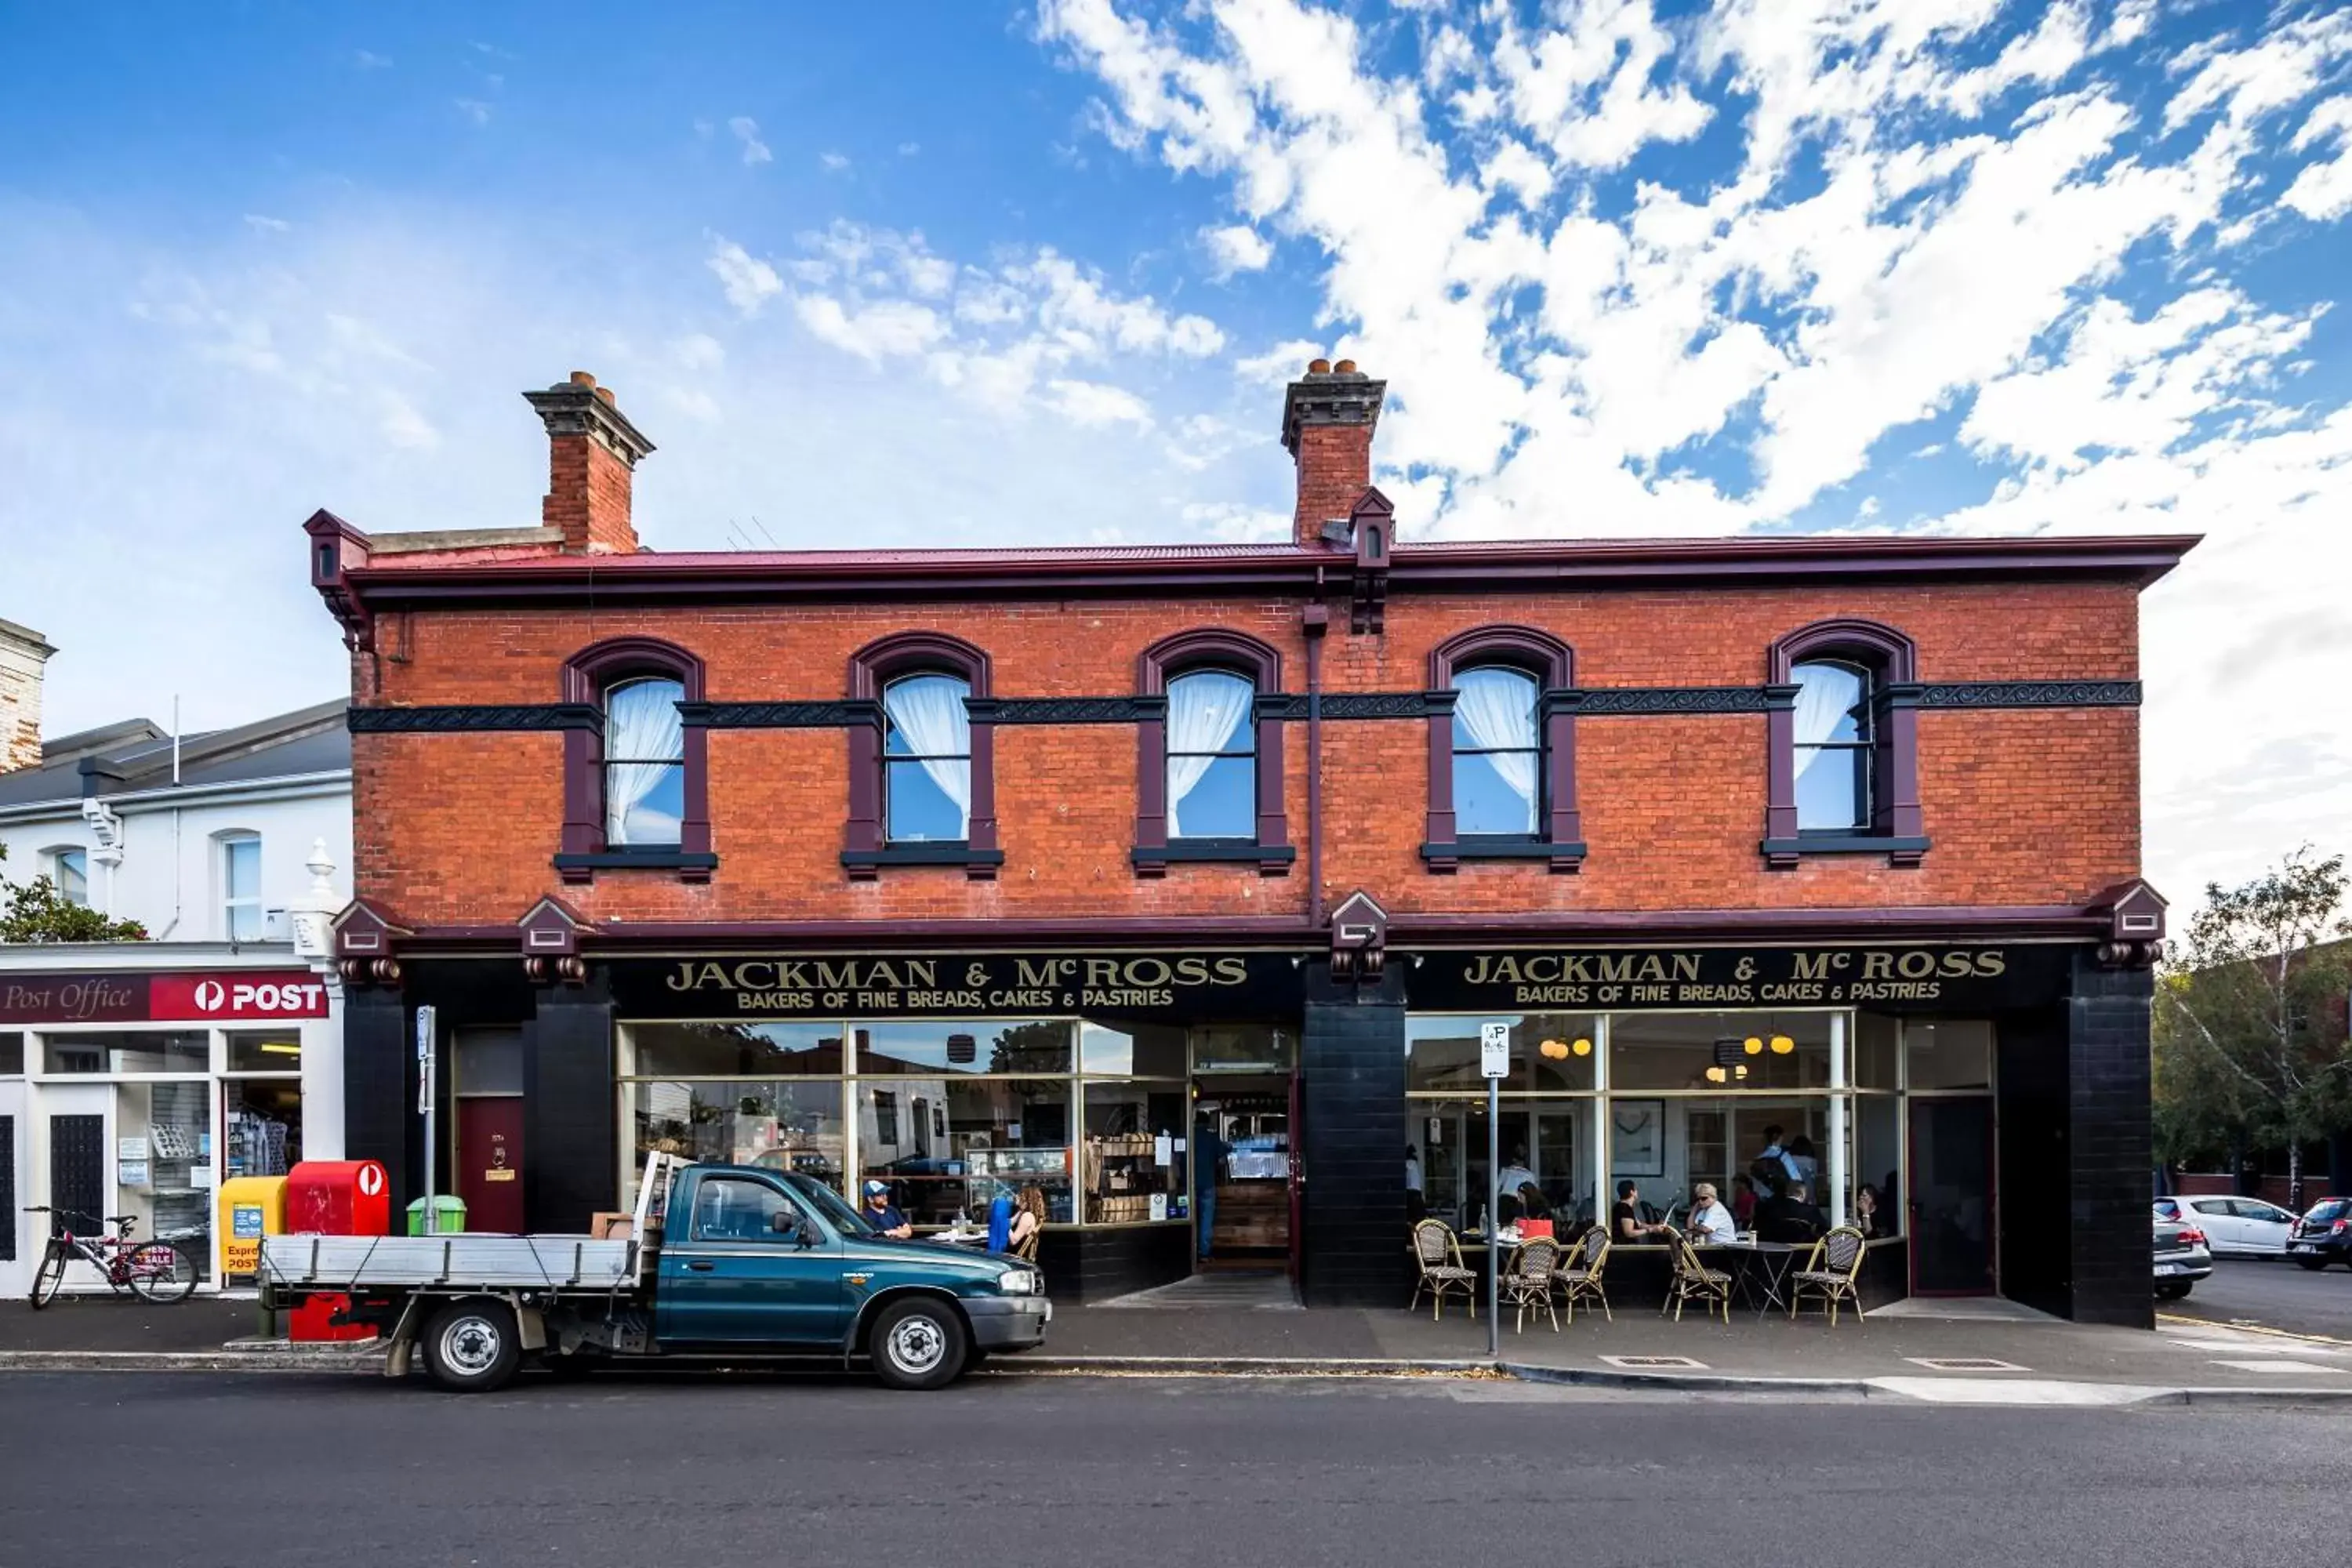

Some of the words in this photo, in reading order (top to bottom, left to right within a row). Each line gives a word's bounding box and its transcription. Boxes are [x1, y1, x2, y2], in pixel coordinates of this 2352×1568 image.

[666, 960, 937, 991] JACKMAN
[965, 963, 992, 987] &
[1464, 954, 1703, 984] JACKMAN
[1734, 956, 1759, 981] &
[4, 985, 52, 1010] Post
[59, 978, 132, 1019] Office
[233, 984, 323, 1011] POST
[737, 992, 815, 1009] BAKERS
[822, 992, 849, 1007] OF
[856, 992, 899, 1007] FINE
[906, 989, 985, 1009] BREADS,
[989, 990, 1054, 1007] CAKES
[1062, 993, 1076, 1007] &
[1081, 989, 1174, 1007] PASTRIES
[1515, 985, 1589, 1003] BAKERS
[1597, 985, 1624, 1002] OF
[1631, 985, 1671, 1001] FINE
[1678, 984, 1755, 1003] BREADS,
[1760, 983, 1824, 1000] CAKES
[1830, 985, 1843, 1000] &
[1849, 982, 1941, 1000] PASTRIES
[145, 1255, 170, 1264] SALE
